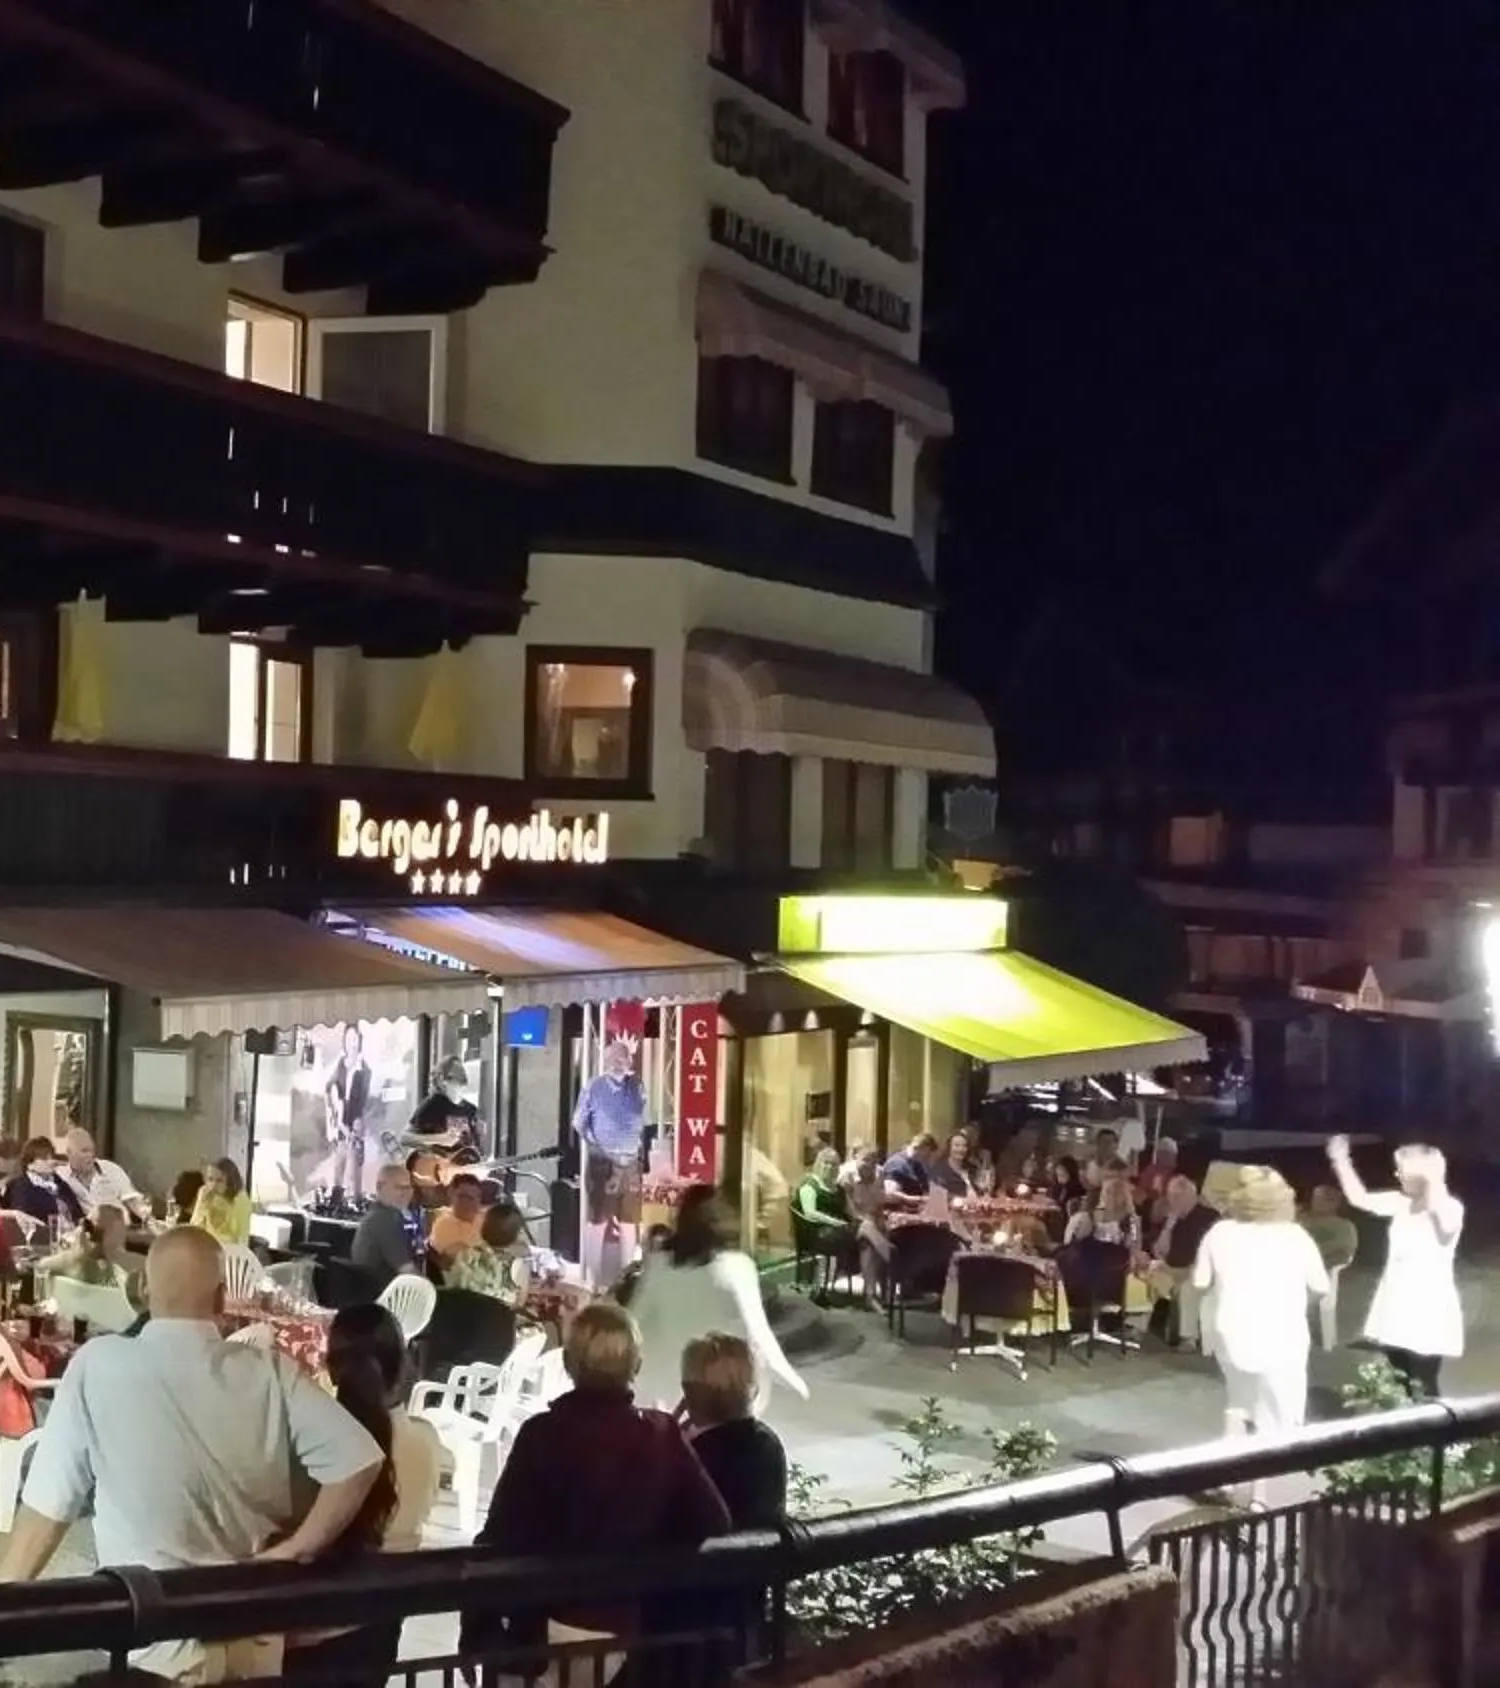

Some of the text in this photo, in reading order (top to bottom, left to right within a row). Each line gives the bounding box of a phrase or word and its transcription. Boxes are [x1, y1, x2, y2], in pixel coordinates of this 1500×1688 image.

[338, 798, 462, 876] Berger's
[686, 1019, 711, 1179] CAT WA
